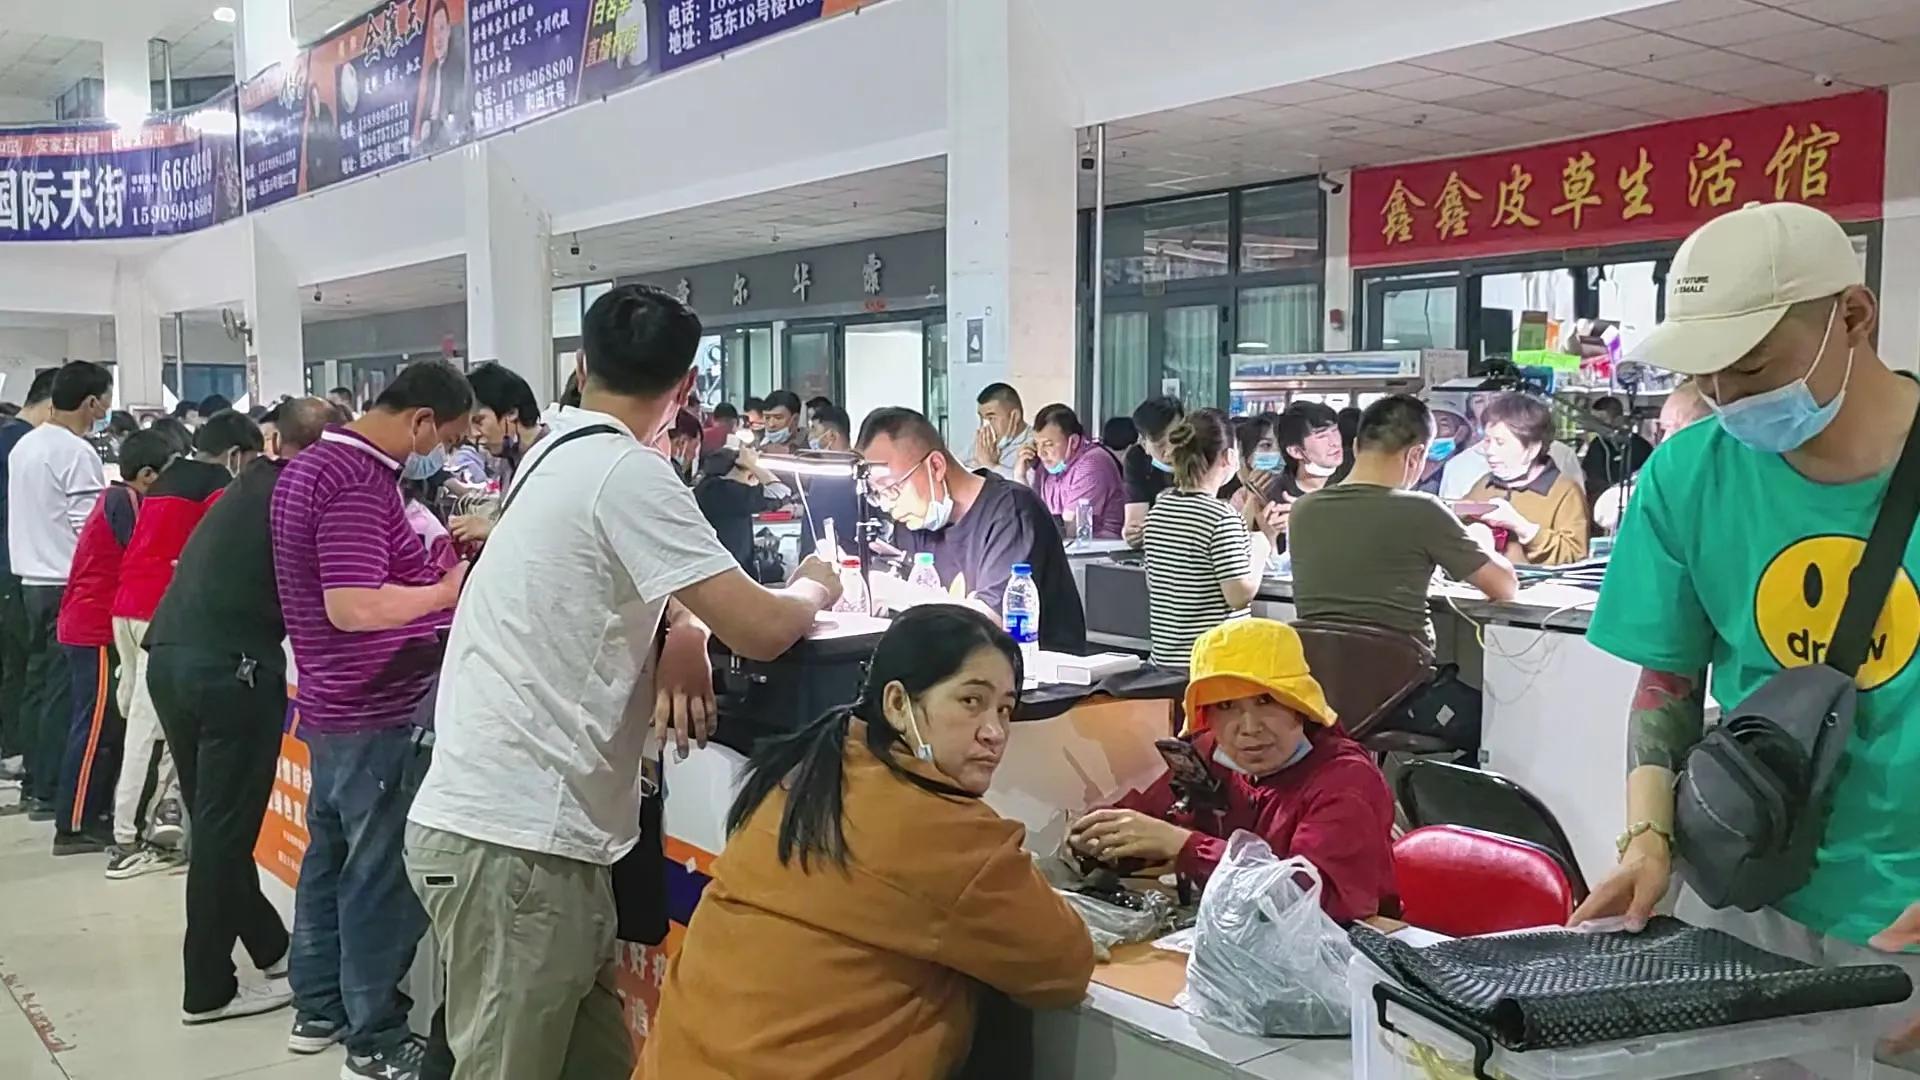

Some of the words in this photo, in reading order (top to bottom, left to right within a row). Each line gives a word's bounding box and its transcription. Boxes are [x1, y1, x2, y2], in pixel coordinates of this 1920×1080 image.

[668, 0, 814, 55] 地址:远东18号楼
[0, 165, 124, 231] 国际天街
[1380, 124, 1841, 246] 鑫鑫皮草生活馆
[1787, 628, 1888, 665] drw
